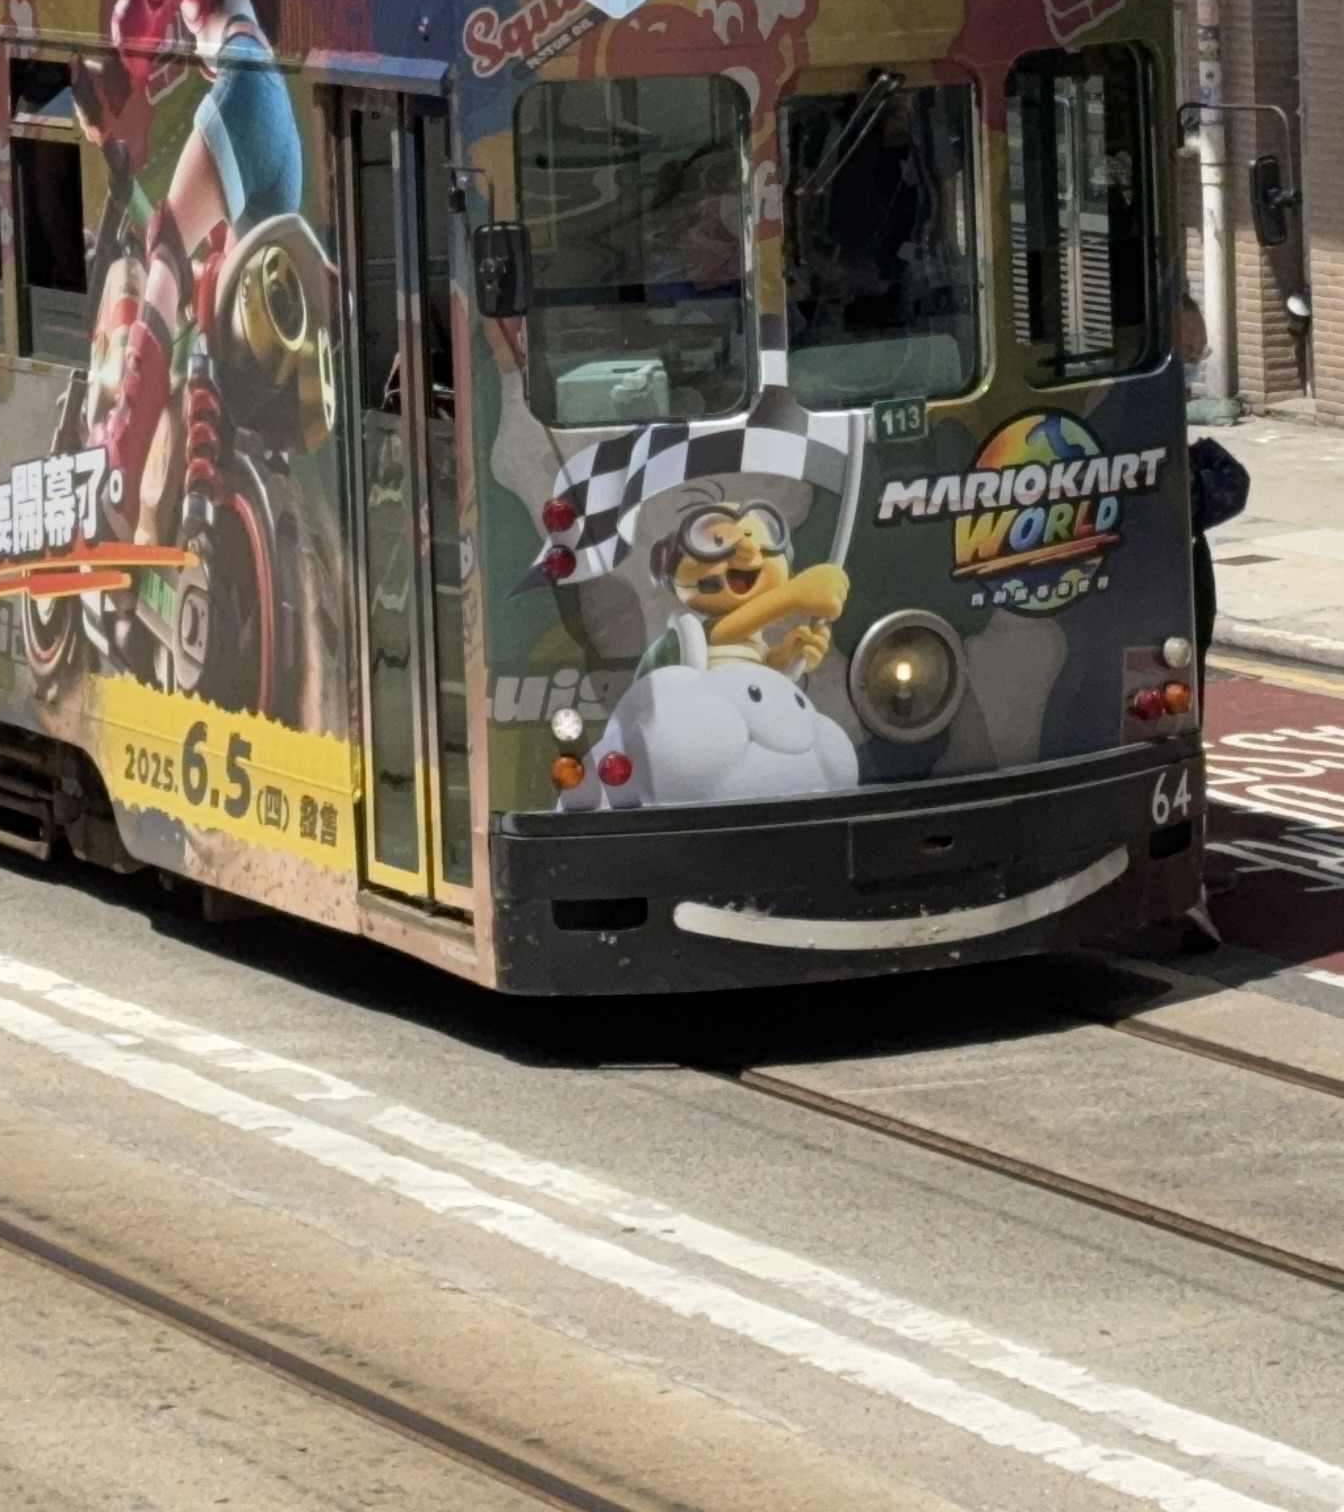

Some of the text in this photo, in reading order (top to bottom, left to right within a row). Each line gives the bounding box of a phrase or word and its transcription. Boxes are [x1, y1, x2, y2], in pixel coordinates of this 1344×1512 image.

[881, 405, 921, 436] 113
[955, 495, 1120, 566] WORLD
[1152, 773, 1193, 825] 64
